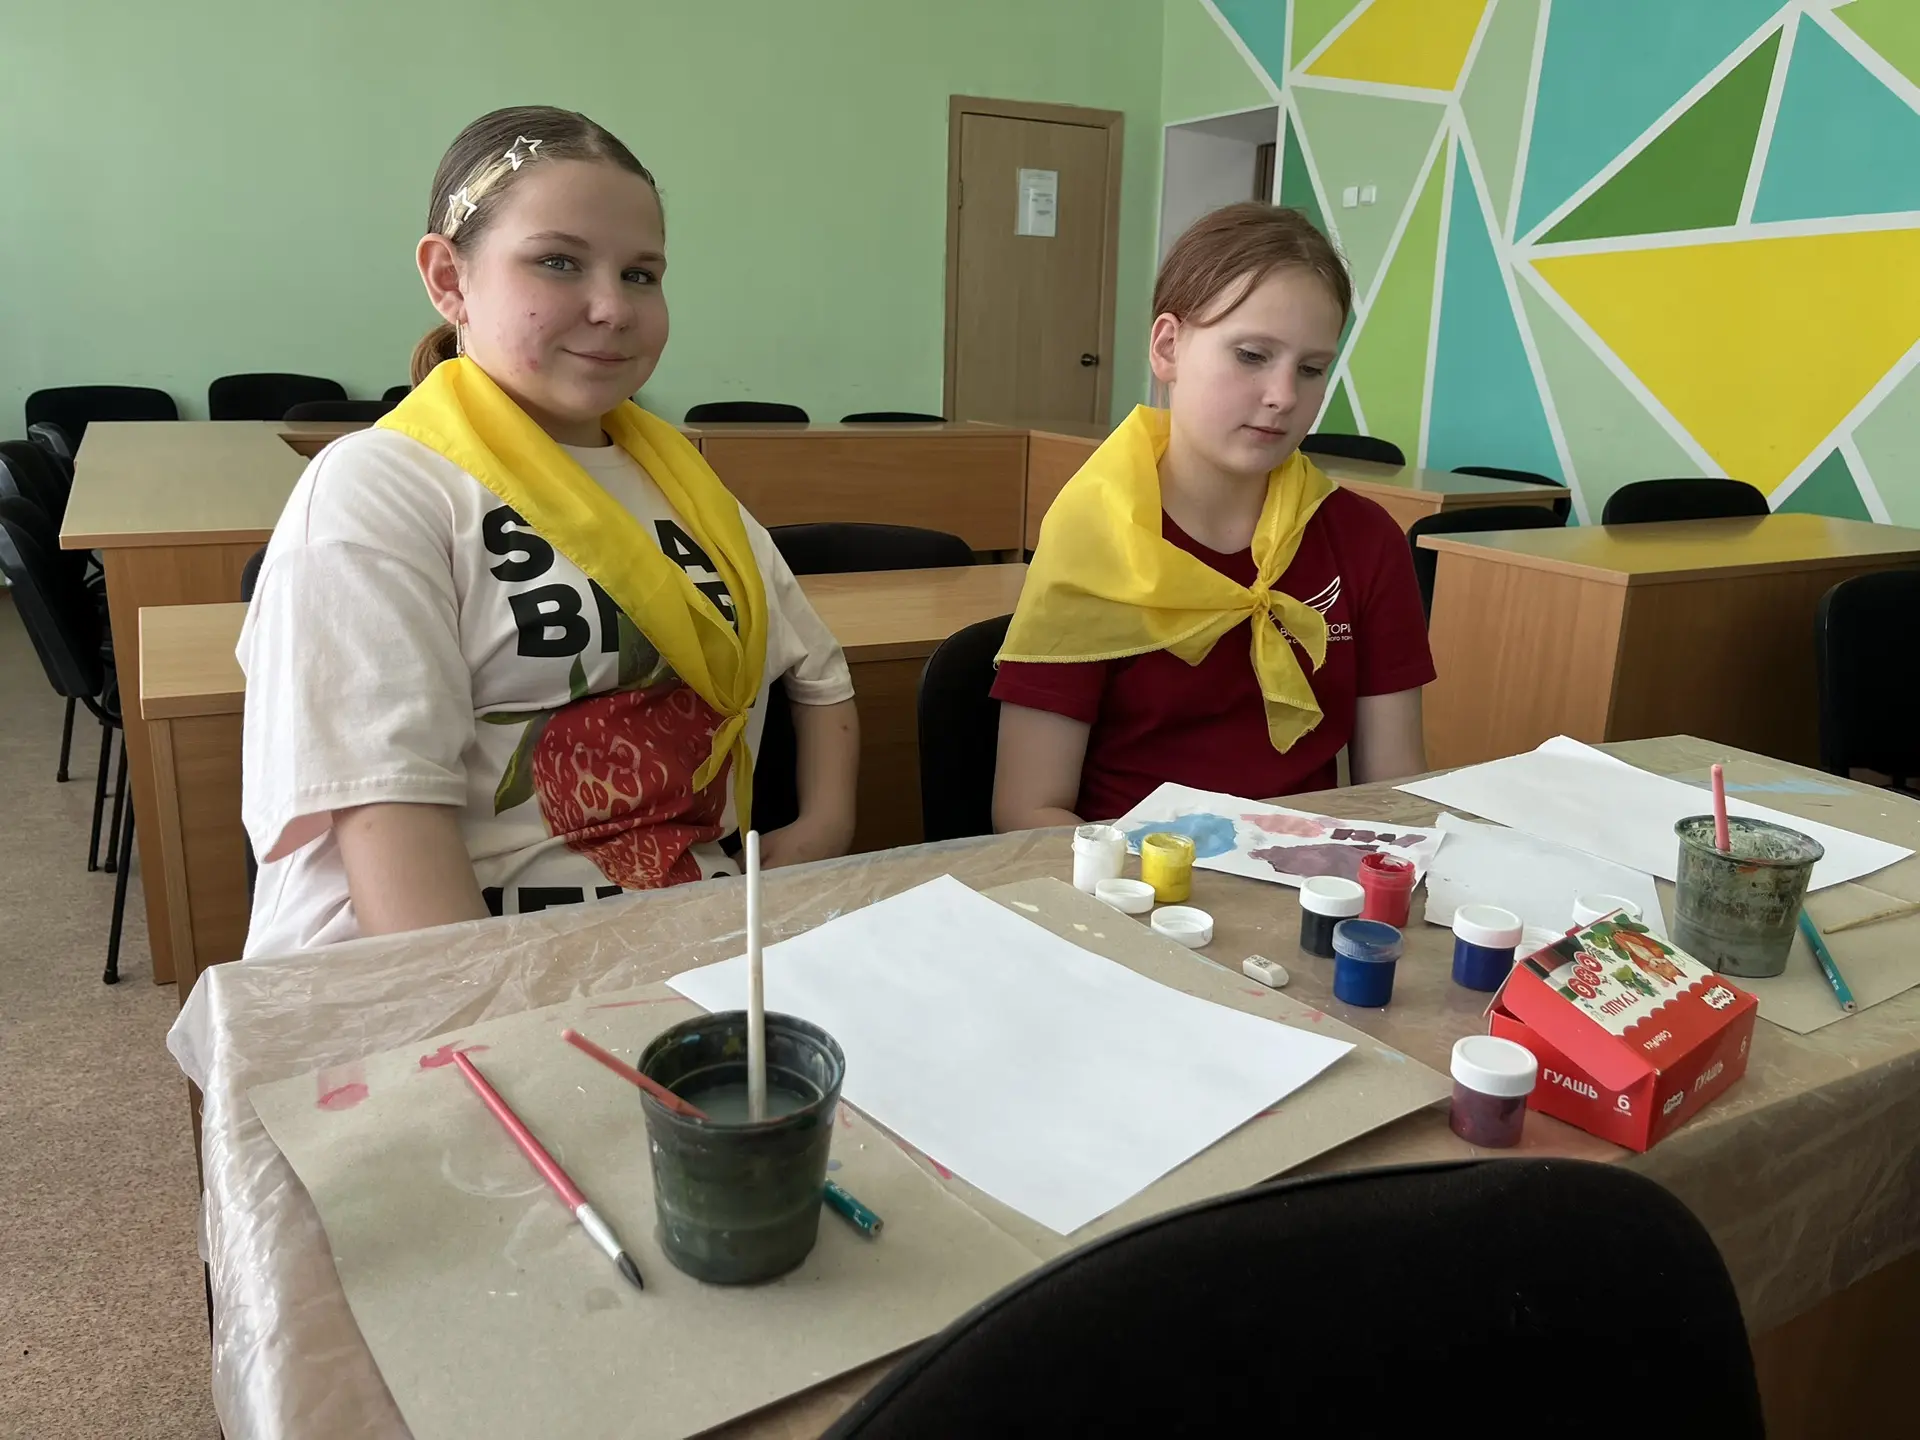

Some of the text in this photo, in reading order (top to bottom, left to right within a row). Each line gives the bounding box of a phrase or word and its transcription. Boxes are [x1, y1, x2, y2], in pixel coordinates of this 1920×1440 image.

[1600, 990, 1639, 1016] ГУАШЬ
[1543, 1067, 1599, 1100] ГУАШЬ
[1694, 1060, 1724, 1093] ГУАШЬ
[1617, 1093, 1631, 1111] 6
